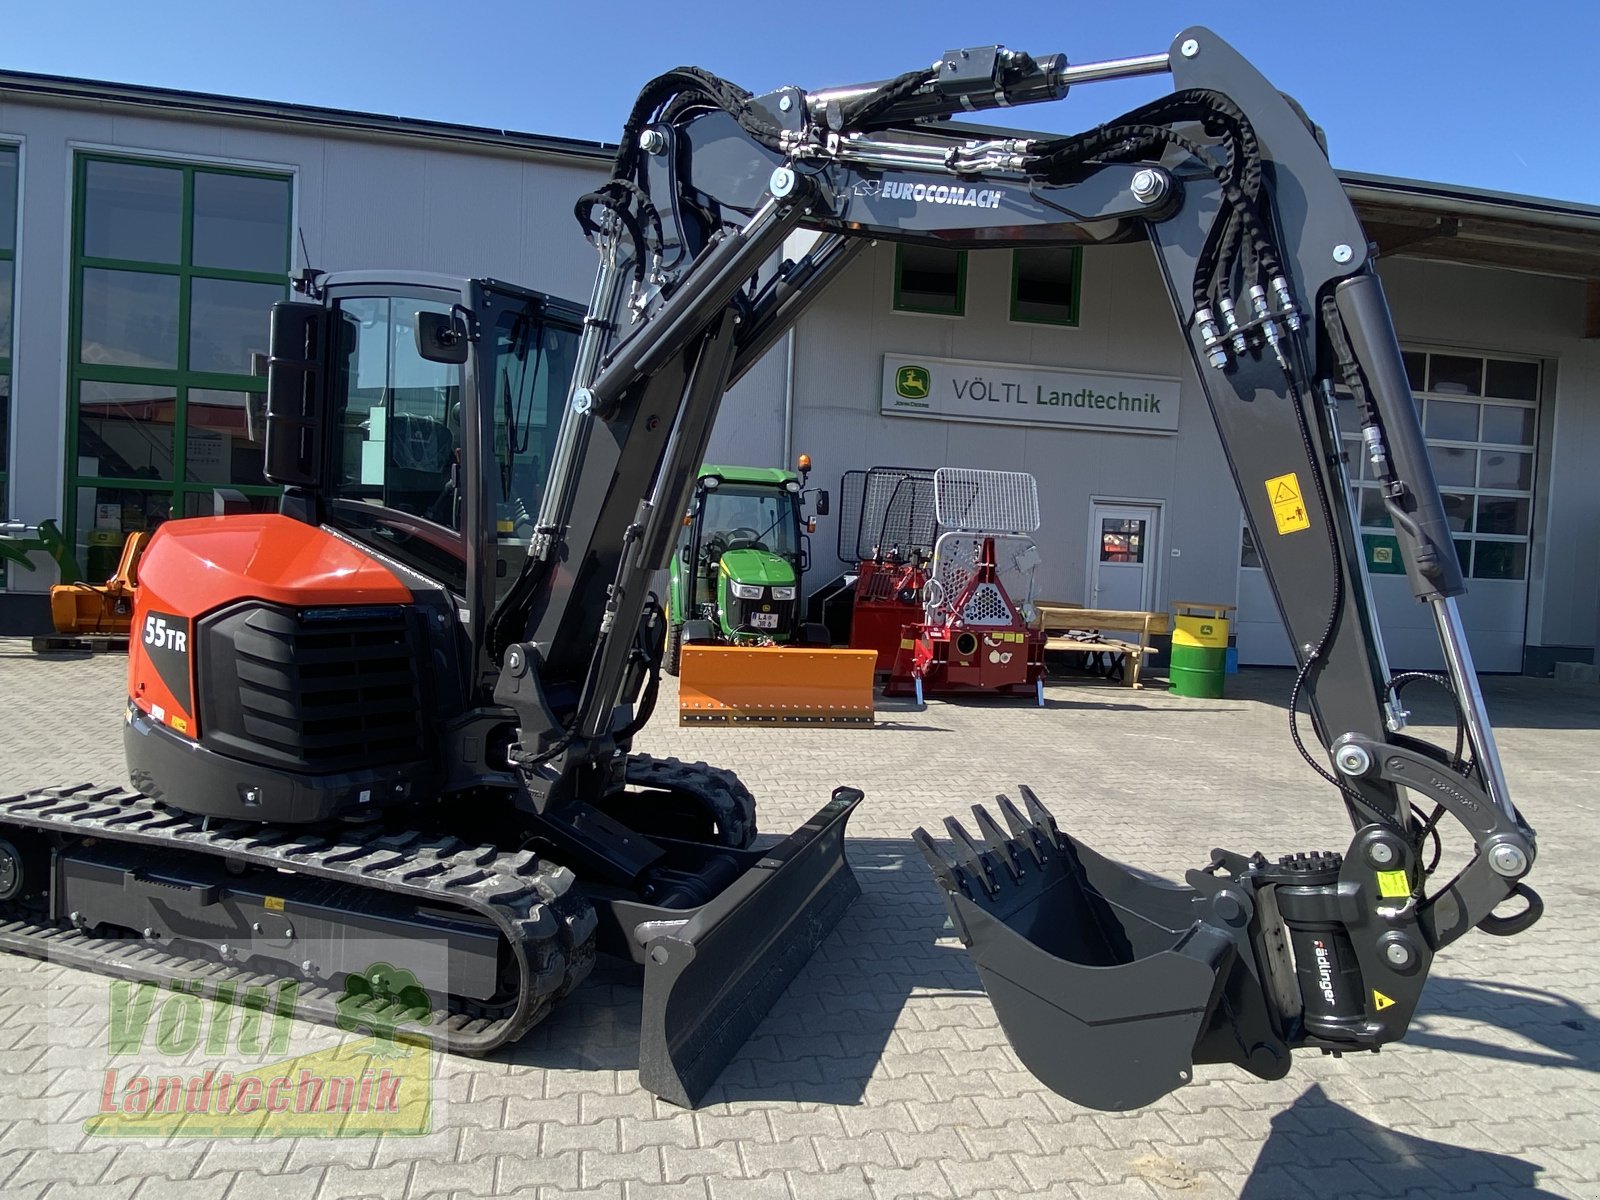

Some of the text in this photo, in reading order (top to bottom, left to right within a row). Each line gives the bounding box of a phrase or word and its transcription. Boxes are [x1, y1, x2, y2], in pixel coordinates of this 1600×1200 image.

[882, 181, 1001, 209] EUROCOMACH
[952, 377, 1161, 414] VÖLTL Landtechnik
[144, 616, 187, 653] 55TR
[1313, 940, 1336, 1006] rädlinger
